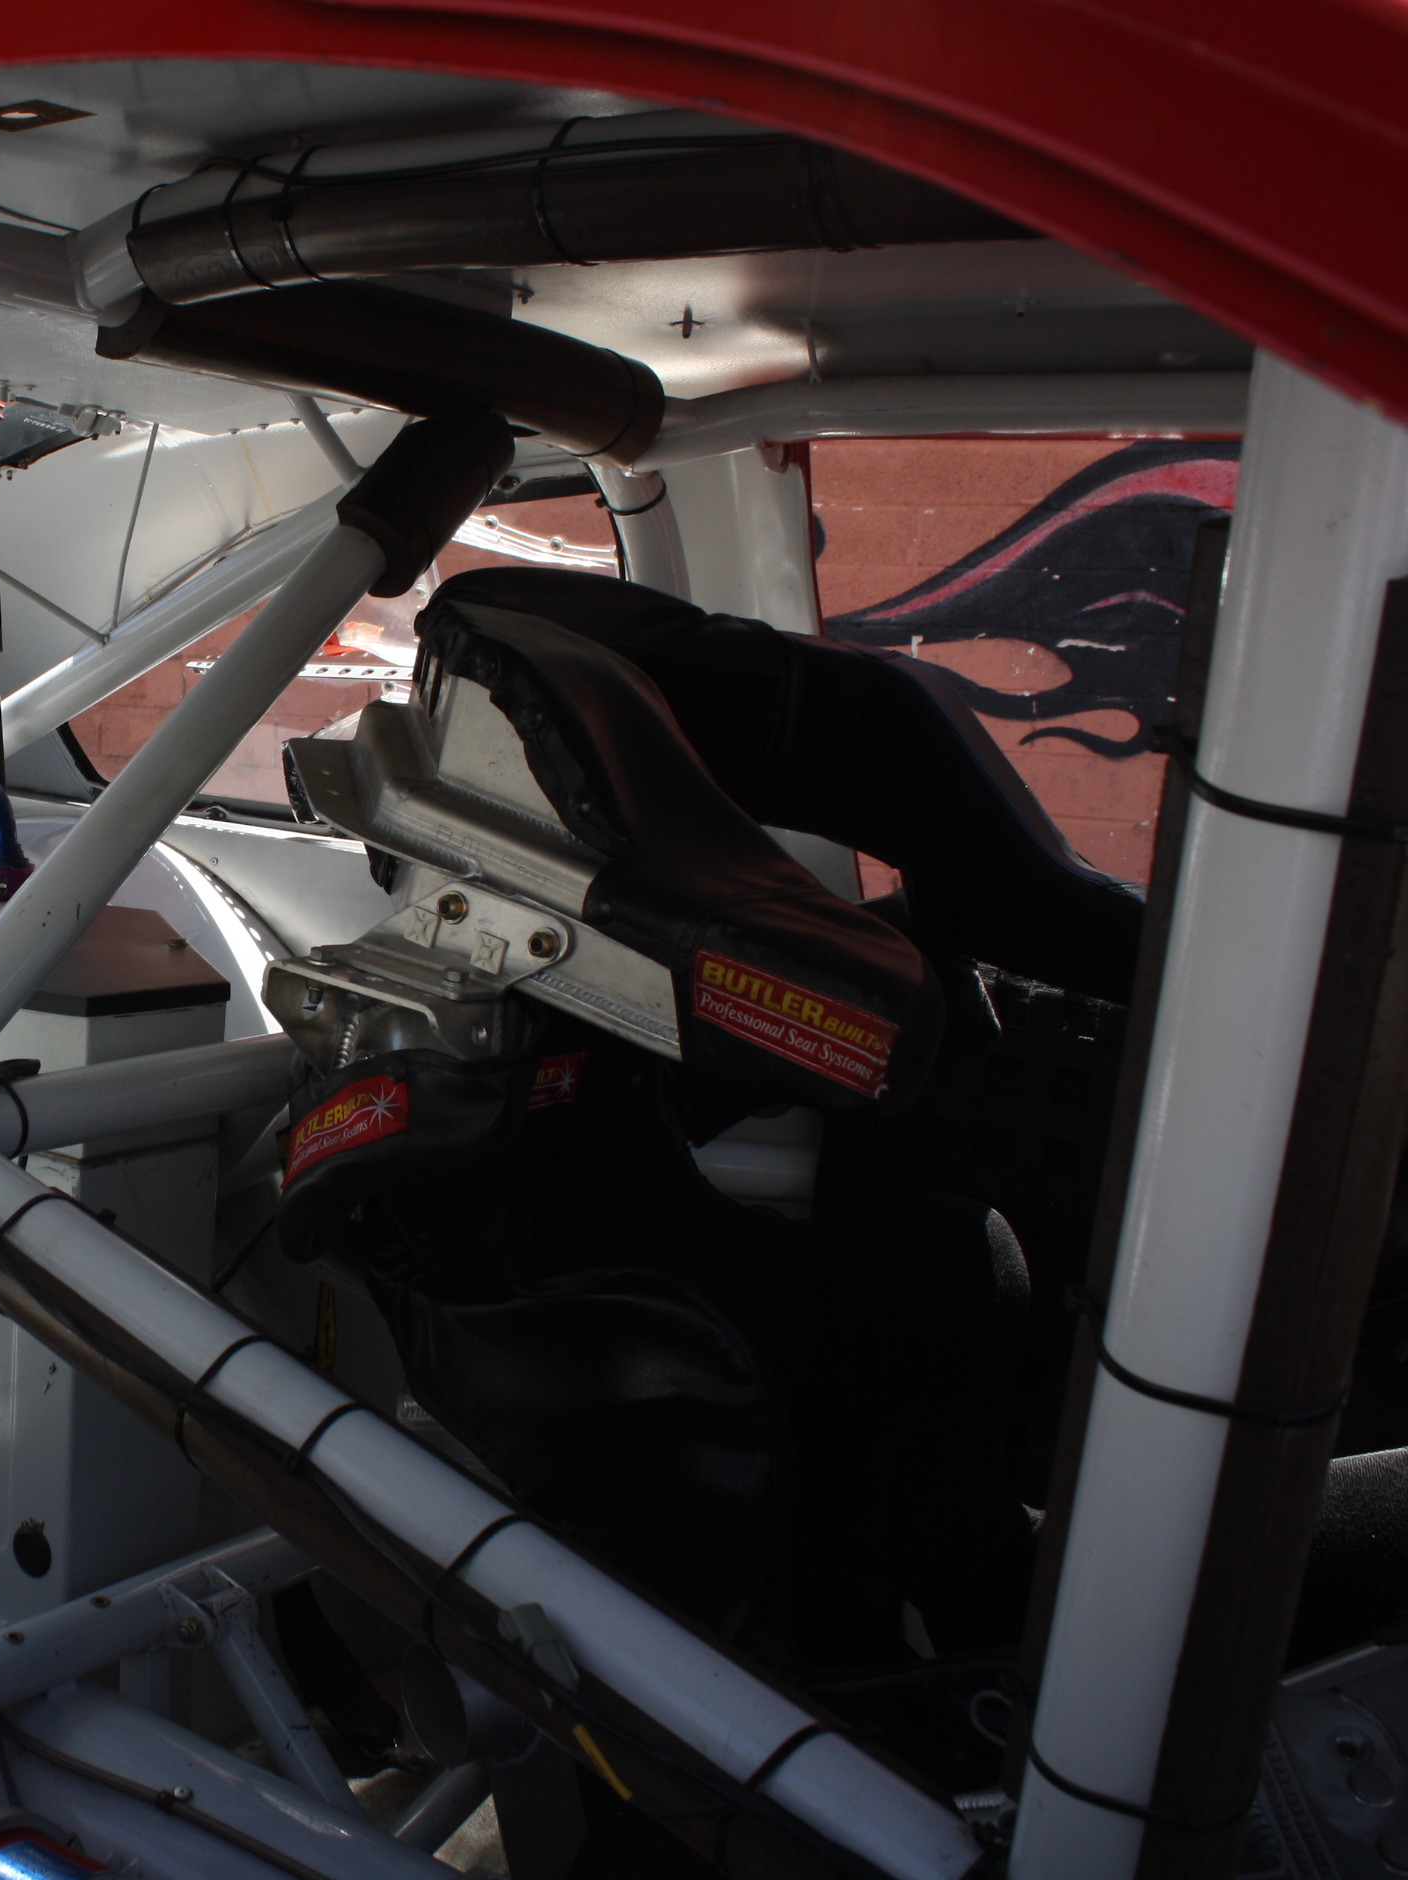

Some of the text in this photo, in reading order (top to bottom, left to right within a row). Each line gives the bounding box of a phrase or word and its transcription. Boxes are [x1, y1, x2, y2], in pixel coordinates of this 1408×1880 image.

[701, 992, 873, 1081] Professional Seat Systems
